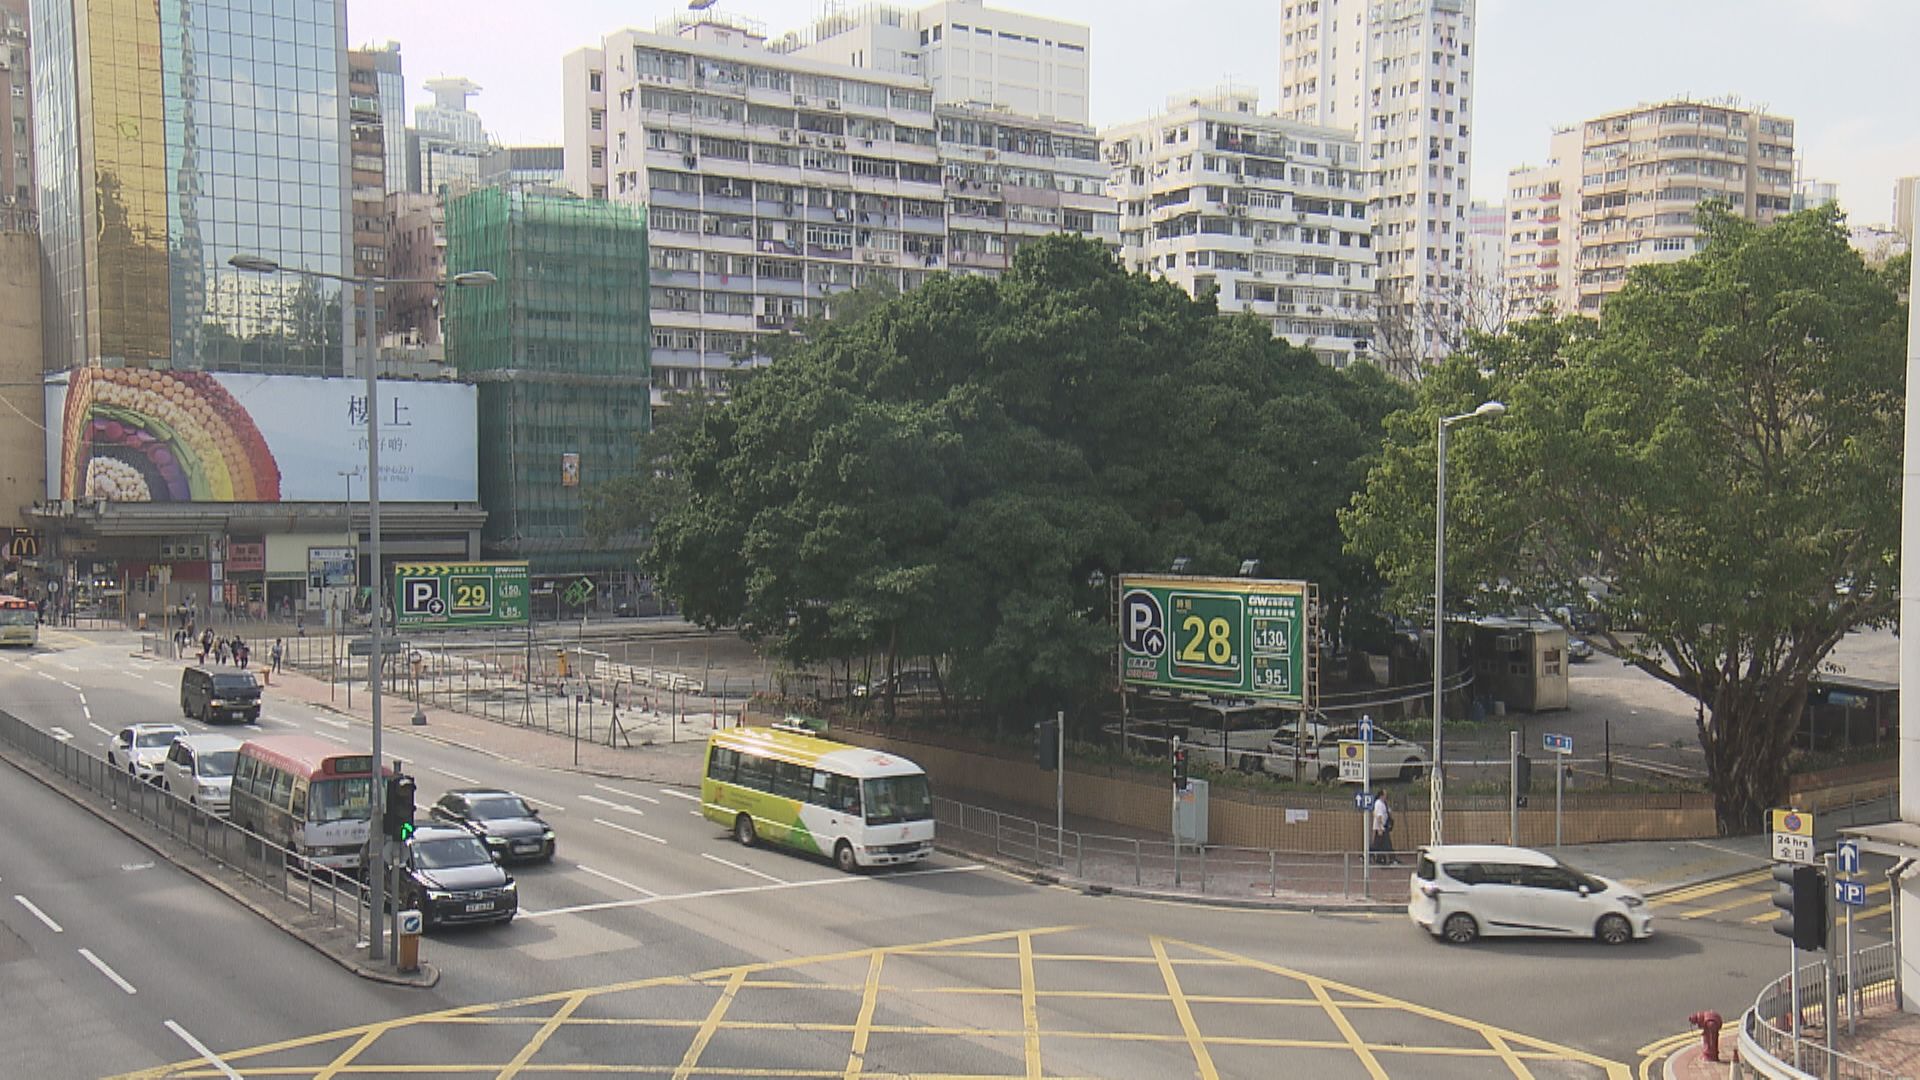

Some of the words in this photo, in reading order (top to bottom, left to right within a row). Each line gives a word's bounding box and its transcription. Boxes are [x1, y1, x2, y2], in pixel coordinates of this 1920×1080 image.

[413, 582, 433, 609] P
[457, 584, 486, 607] 29
[1130, 602, 1153, 642] P
[1182, 615, 1231, 664] 28
[1260, 629, 1283, 647] 130
[1265, 668, 1282, 686] 95
[1364, 794, 1372, 808] P
[1777, 835, 1790, 845] 24
[1792, 837, 1808, 848] hrs
[1781, 848, 1804, 860] 全日
[1849, 887, 1860, 902] P
